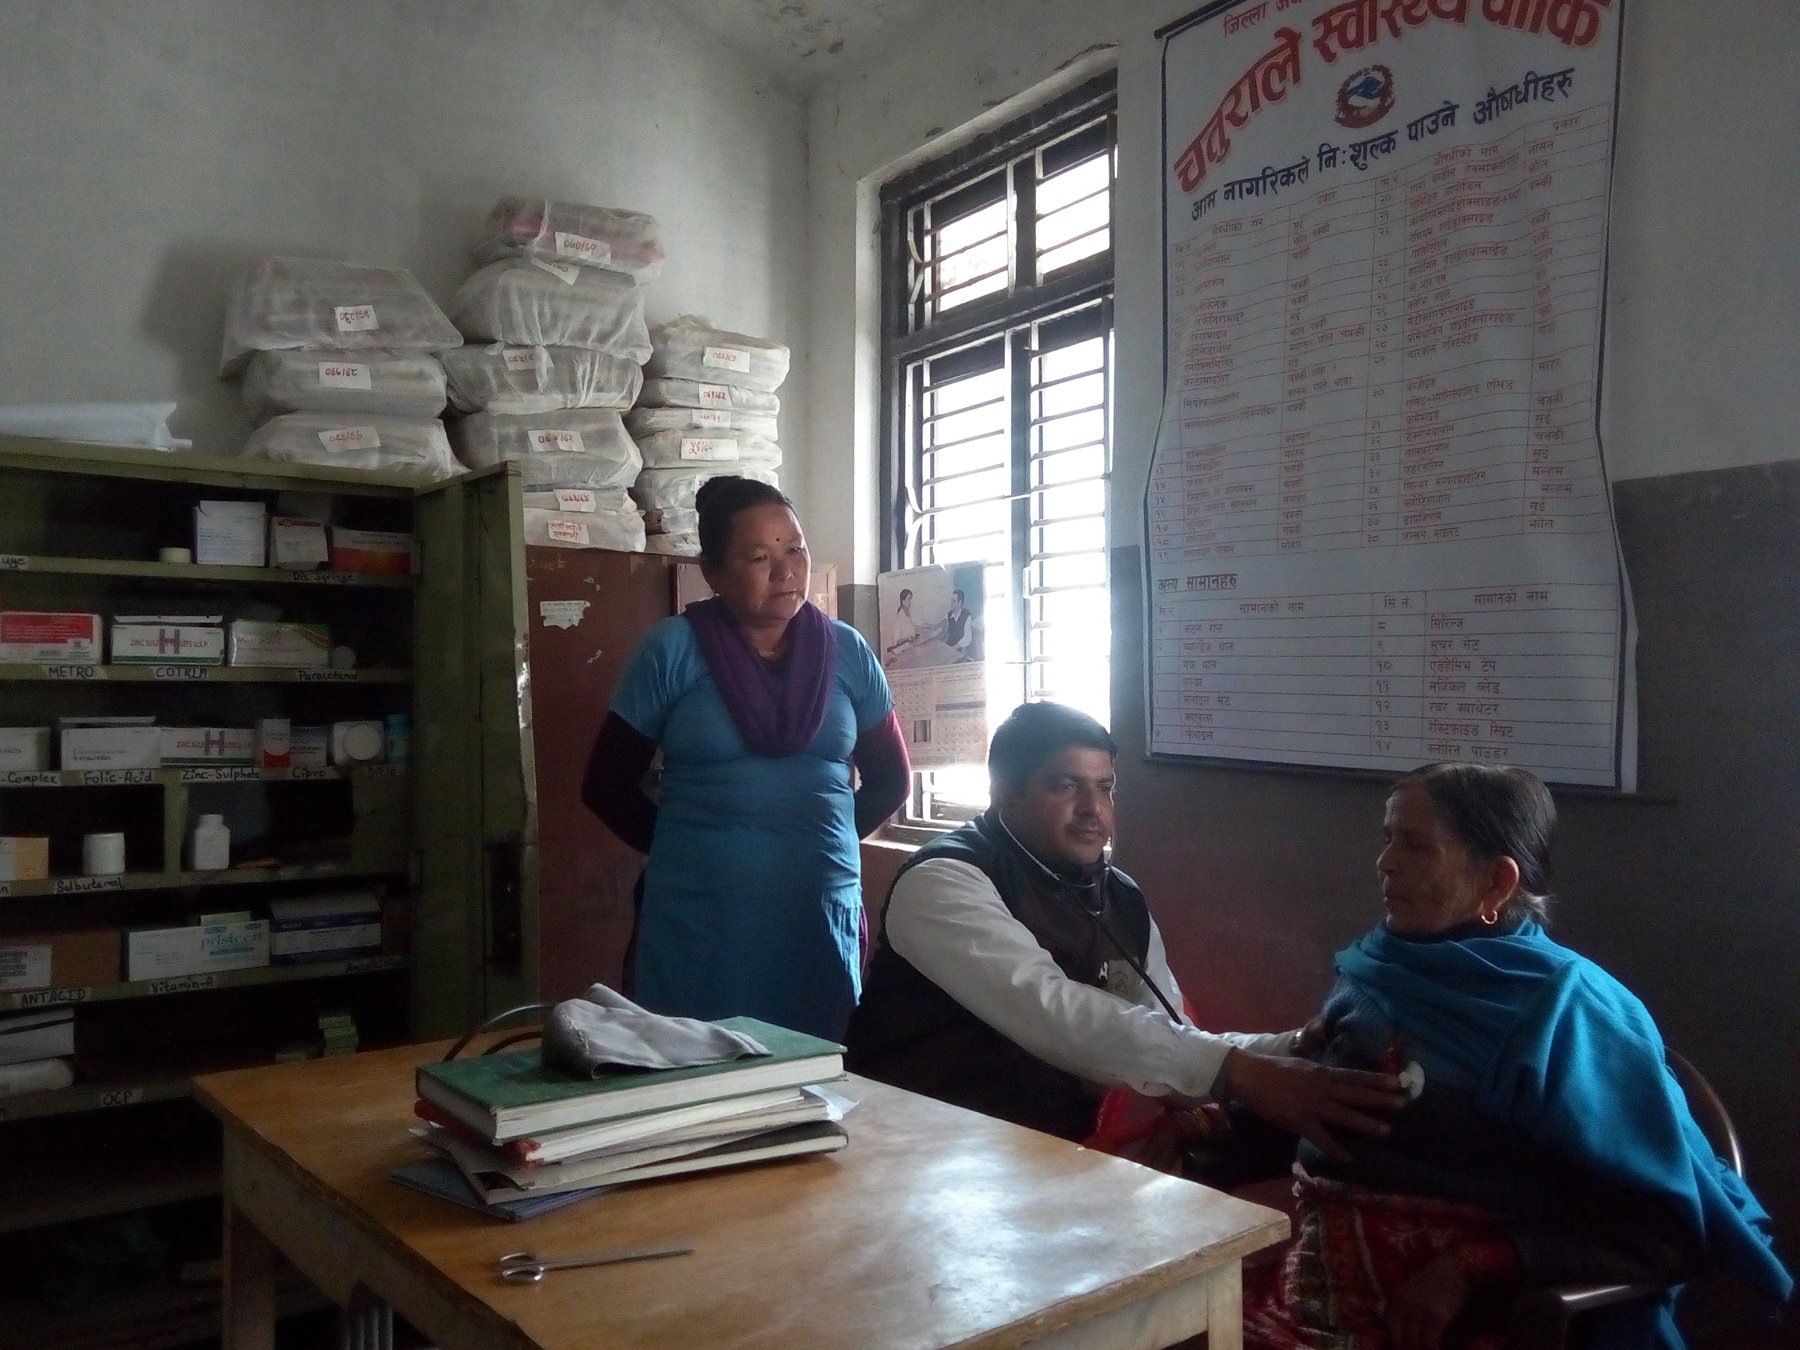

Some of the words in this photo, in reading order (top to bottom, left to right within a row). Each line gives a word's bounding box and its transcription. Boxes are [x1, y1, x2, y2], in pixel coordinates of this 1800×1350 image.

[1192, 190, 1218, 220] आम
[1224, 156, 1310, 200] नागरिकले
[1407, 104, 1460, 141] पाउने
[1473, 588, 1517, 605] सामानको
[1527, 591, 1549, 602] नाम
[1288, 602, 1304, 613] नाम
[1463, 637, 1480, 650] सेट
[1481, 658, 1496, 672] टेप
[48, 667, 94, 679] METRO
[84, 769, 152, 784] Folic-Acid
[182, 768, 260, 782] Zinc-Sulphate
[291, 767, 324, 781] Cipro
[151, 976, 215, 993] Vitamin-A
[20, 988, 85, 1005] ANTACID
[101, 1091, 131, 1106] OCP
